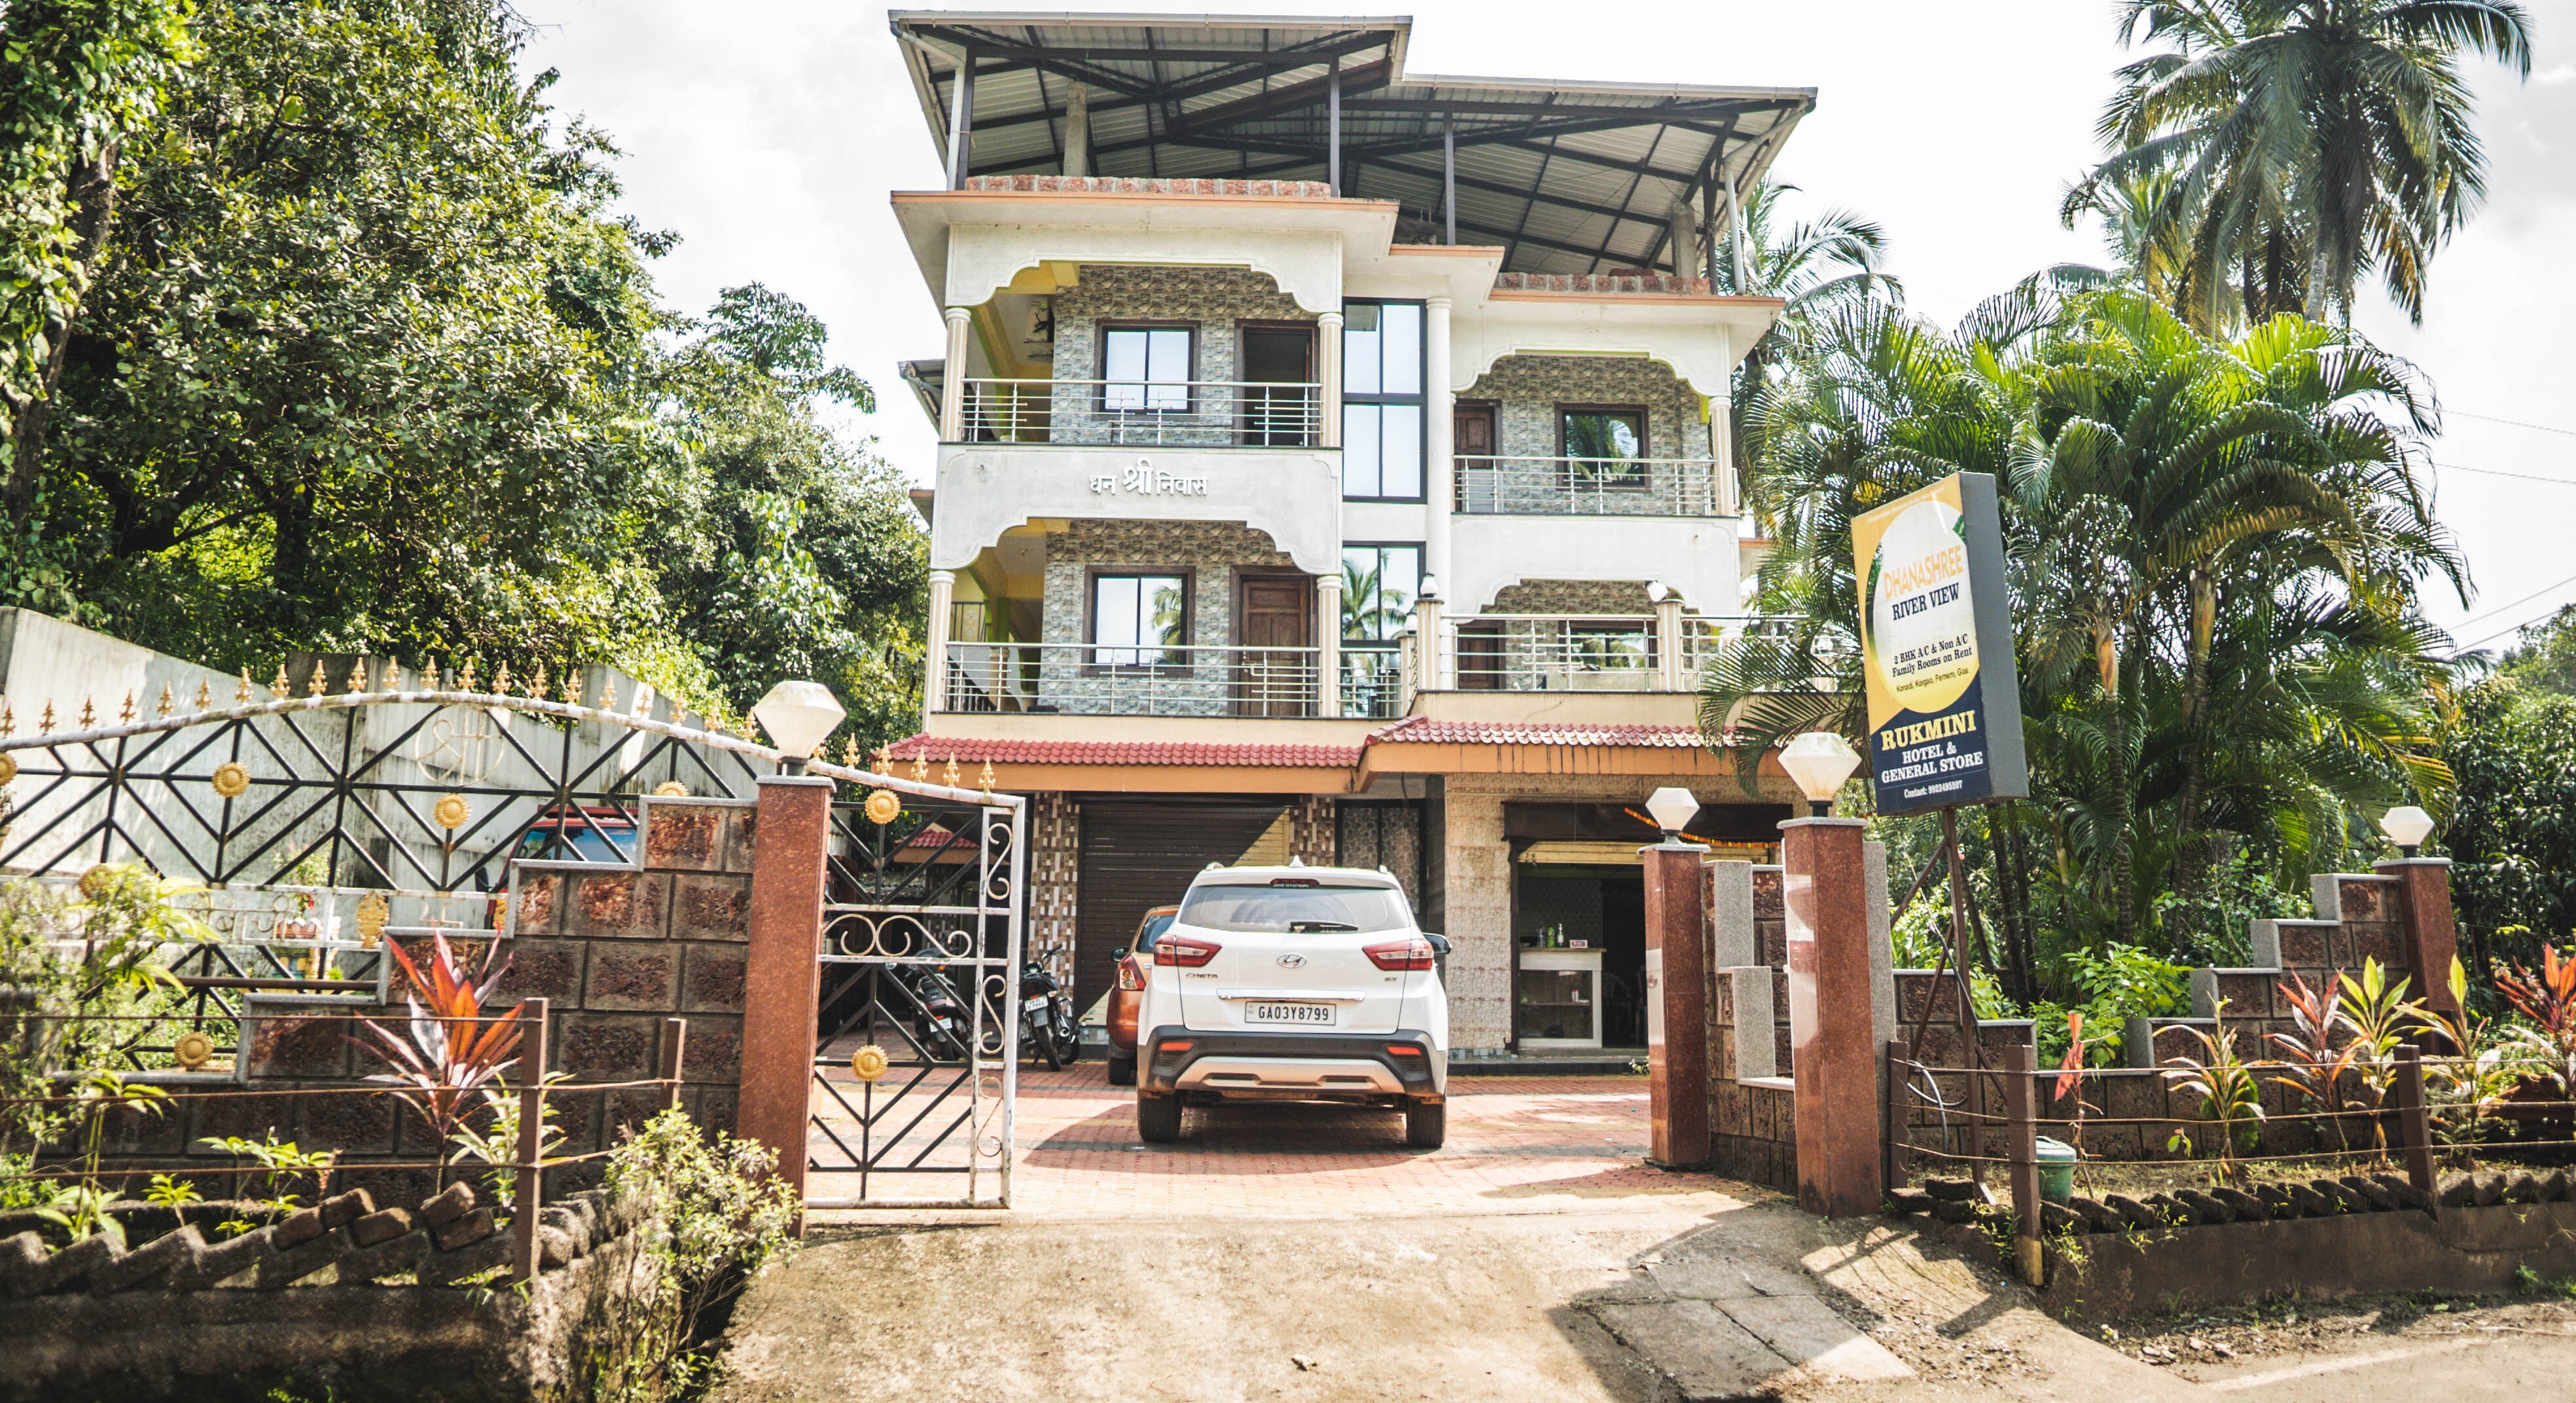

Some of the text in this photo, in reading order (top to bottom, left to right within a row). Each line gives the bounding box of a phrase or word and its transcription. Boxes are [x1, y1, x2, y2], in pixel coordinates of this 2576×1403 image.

[1089, 456, 1208, 496] धन श्री निवास
[1884, 544, 1963, 600] DHANASHREE
[1892, 582, 1959, 621] RIVER VIEW
[1893, 646, 1972, 677] Family Rooms on Rent
[1894, 655, 1899, 665] 2
[1900, 649, 1916, 663] BHK
[1931, 643, 1937, 653] &
[1939, 640, 1954, 651] Non
[1880, 710, 1977, 751] RUKMINI
[1881, 751, 1983, 784] GENERAL STORE
[1902, 741, 1957, 764] HOTEL &
[1904, 786, 1927, 798] Contact:
[1259, 1006, 1329, 1021] GA03Y8799
